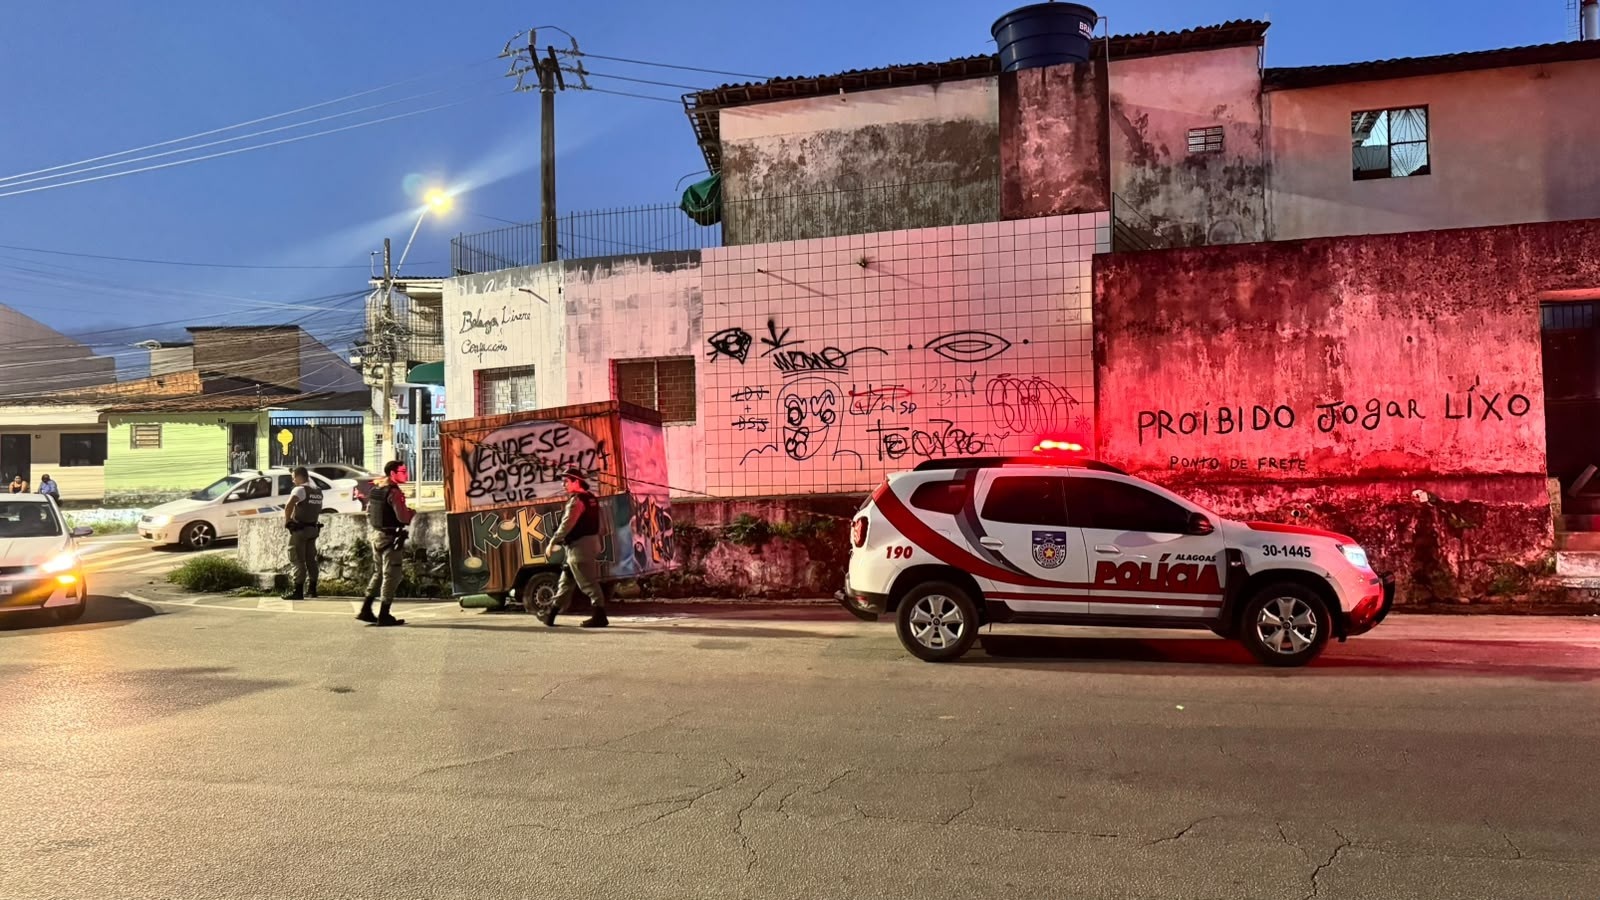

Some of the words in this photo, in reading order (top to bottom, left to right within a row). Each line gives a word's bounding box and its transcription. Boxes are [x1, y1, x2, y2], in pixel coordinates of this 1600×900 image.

[1170, 456, 1220, 470] PONTO
[1230, 458, 1248, 470] DE
[1258, 457, 1306, 471] FRETE
[491, 487, 537, 503] LUIZ
[886, 545, 913, 559] 190
[1175, 553, 1217, 562] ALAGOAS
[1262, 544, 1312, 558] 30-1445
[1094, 553, 1221, 591] POLÍCIA
